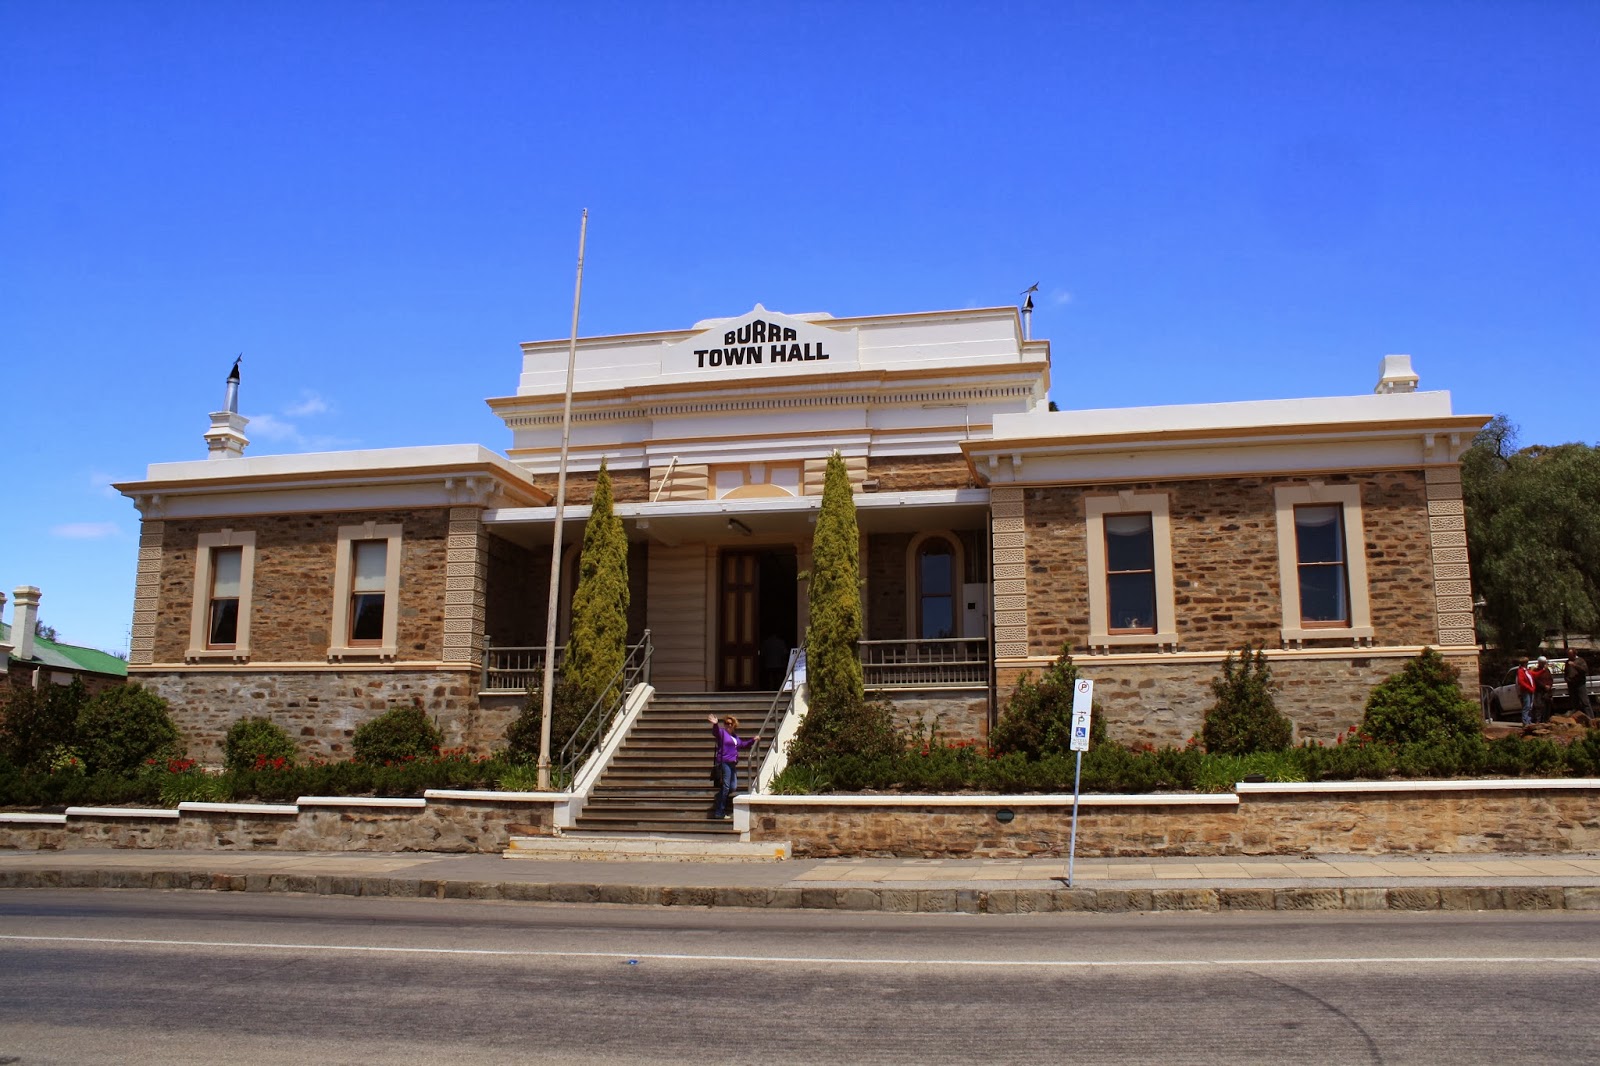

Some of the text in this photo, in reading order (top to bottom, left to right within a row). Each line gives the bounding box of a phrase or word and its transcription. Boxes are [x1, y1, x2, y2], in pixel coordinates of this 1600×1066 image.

[725, 319, 797, 345] BURRA
[694, 342, 830, 368] TOWN HALL
